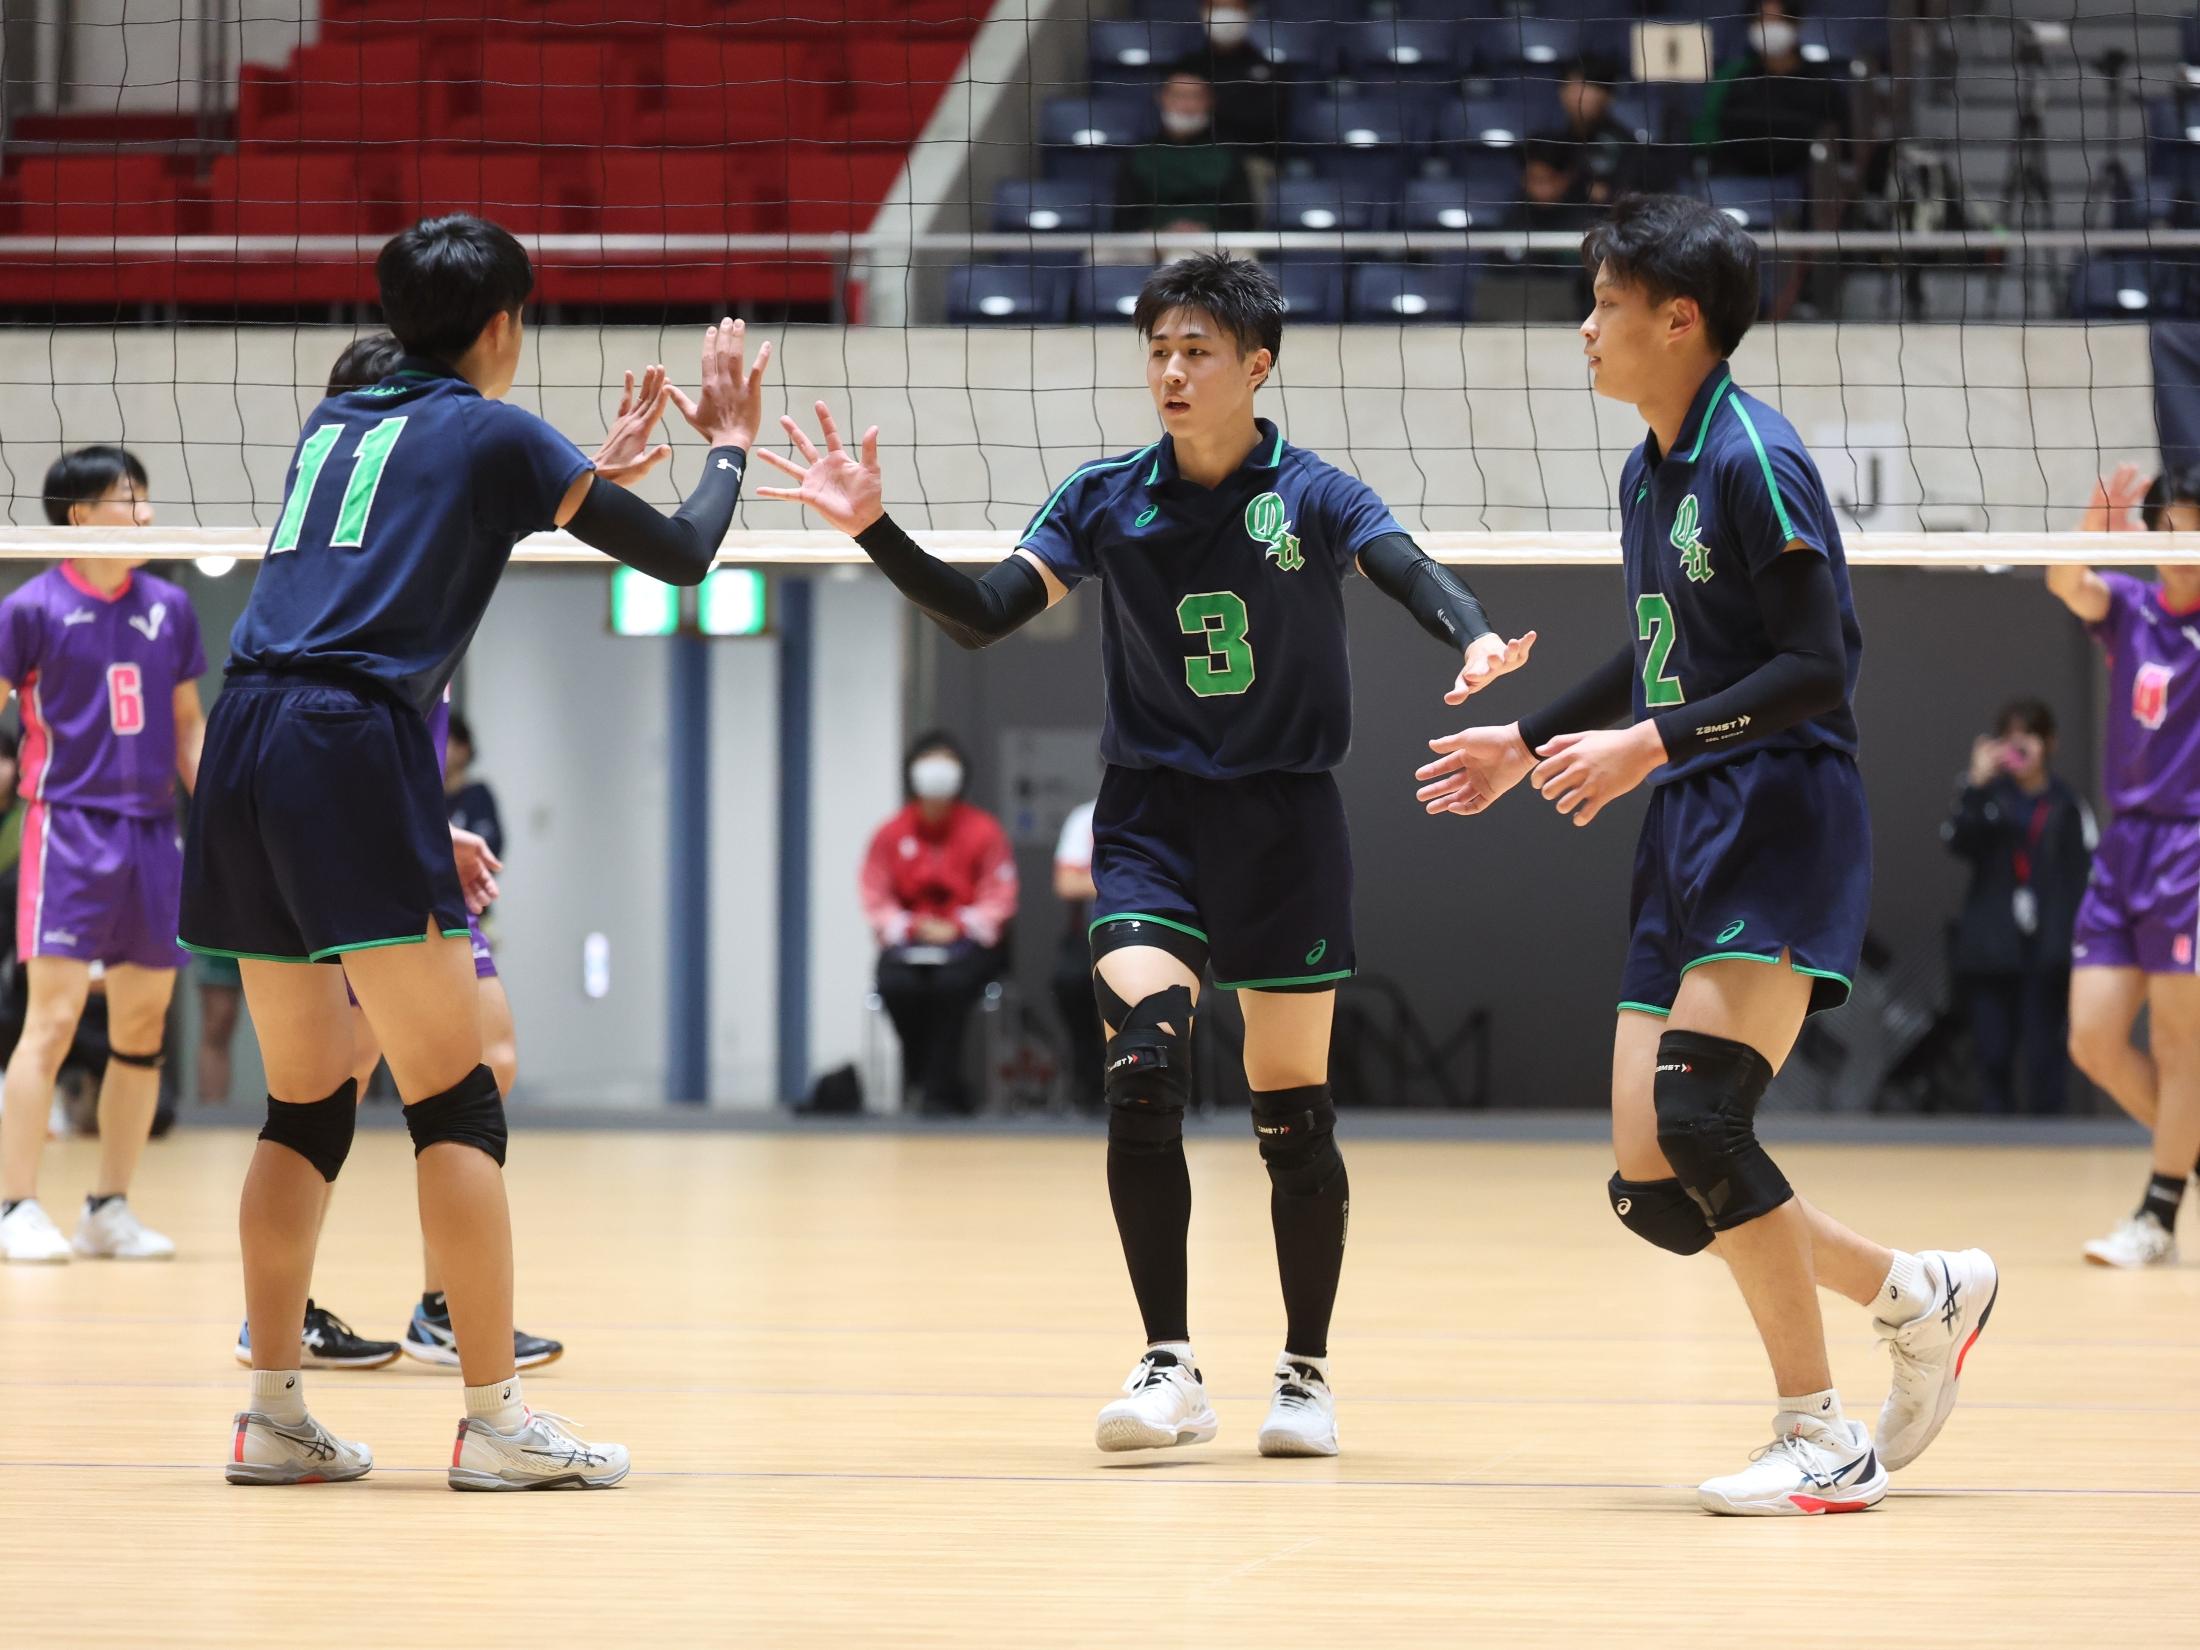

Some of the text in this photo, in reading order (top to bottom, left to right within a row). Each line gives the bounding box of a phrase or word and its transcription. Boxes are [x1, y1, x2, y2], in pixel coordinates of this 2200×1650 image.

[270, 416, 409, 555] 11
[1838, 454, 1882, 521] J
[1175, 590, 1256, 698] 3
[1635, 592, 1687, 708] 2
[106, 662, 145, 736] 6
